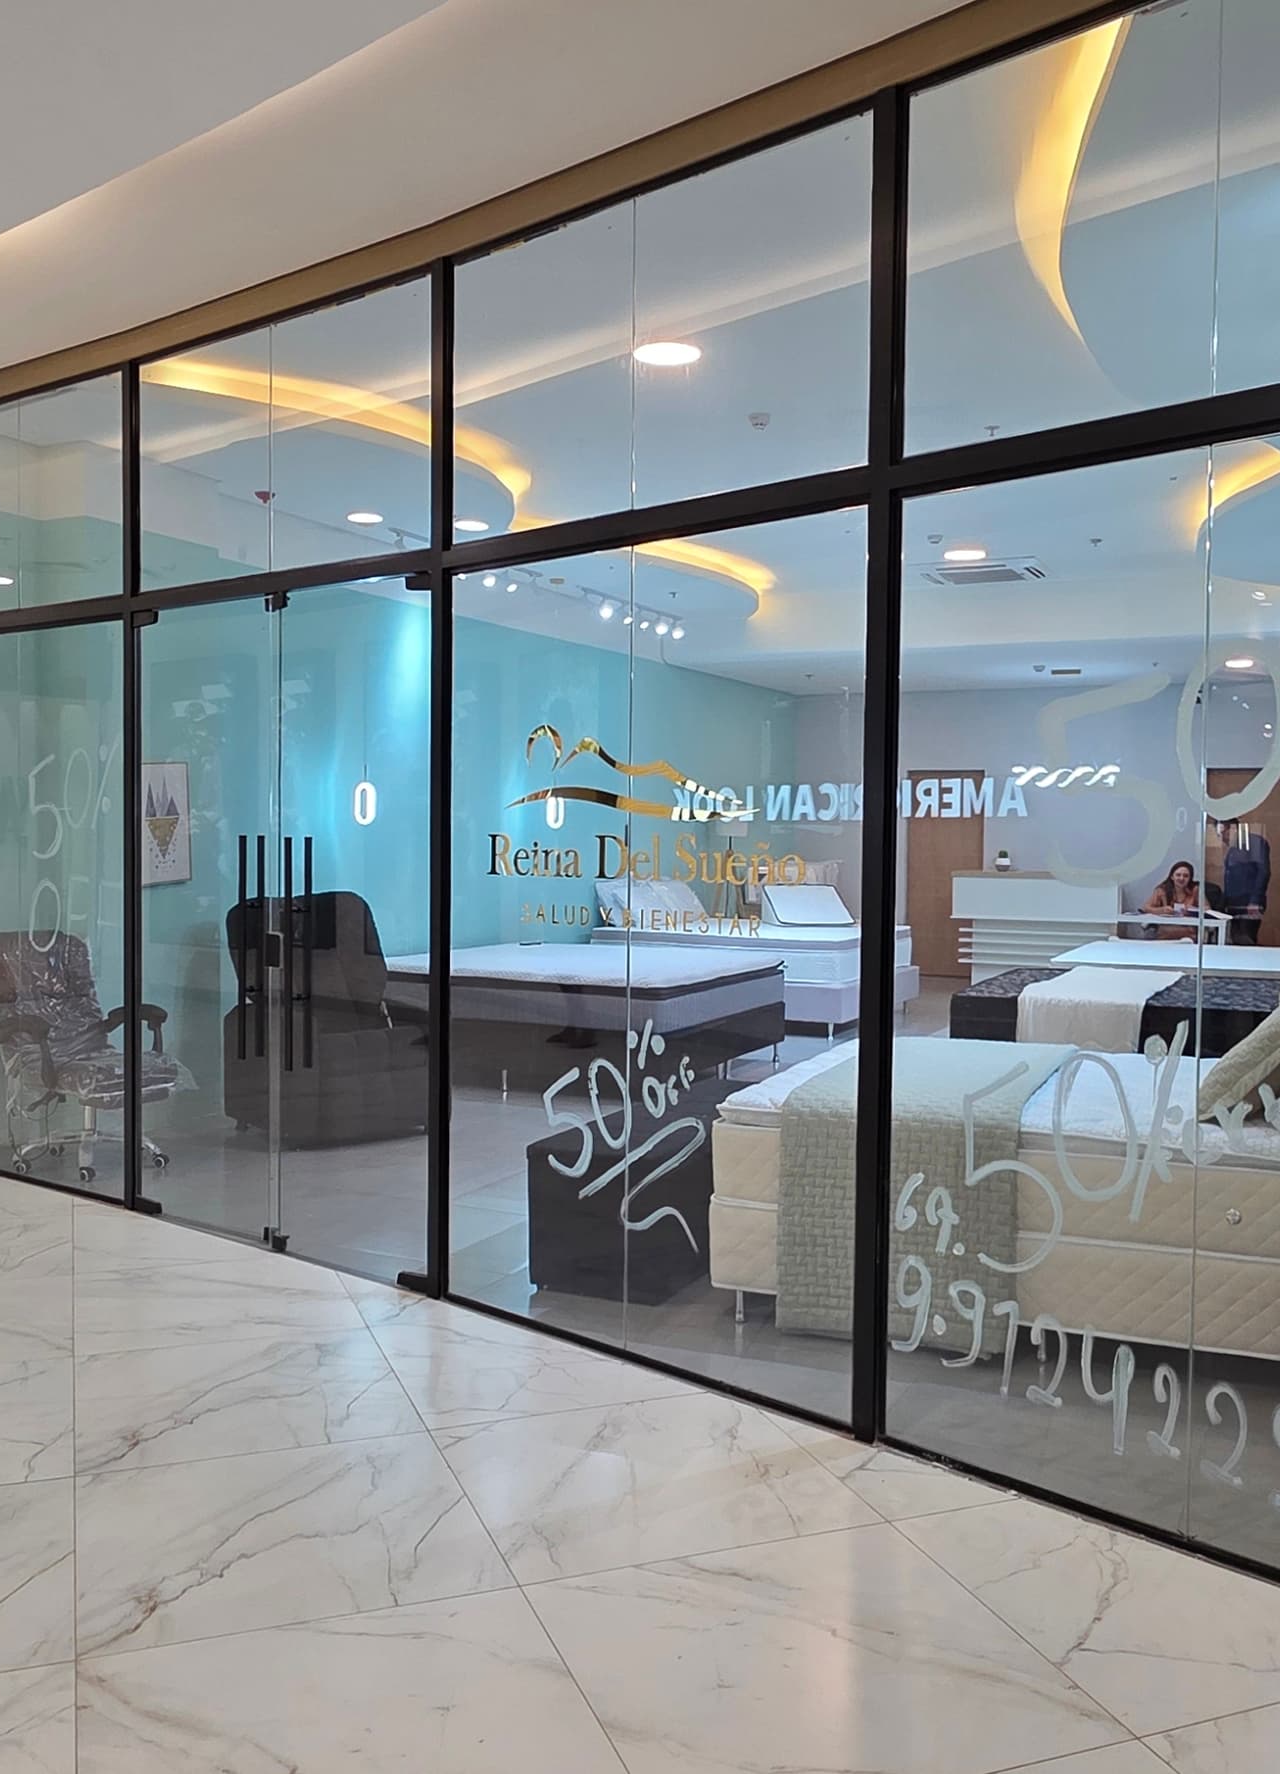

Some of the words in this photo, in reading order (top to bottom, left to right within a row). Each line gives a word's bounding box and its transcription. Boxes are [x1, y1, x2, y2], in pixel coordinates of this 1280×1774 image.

[28, 733, 121, 860] 50%
[486, 833, 582, 879] Reina
[595, 834, 662, 881] Del
[673, 832, 806, 887] Sueño
[29, 876, 121, 956] OFF
[519, 903, 591, 927] SALUD
[622, 908, 762, 938] BIENESTAR
[543, 1018, 666, 1178] 50%
[963, 1019, 1190, 1273] 50%
